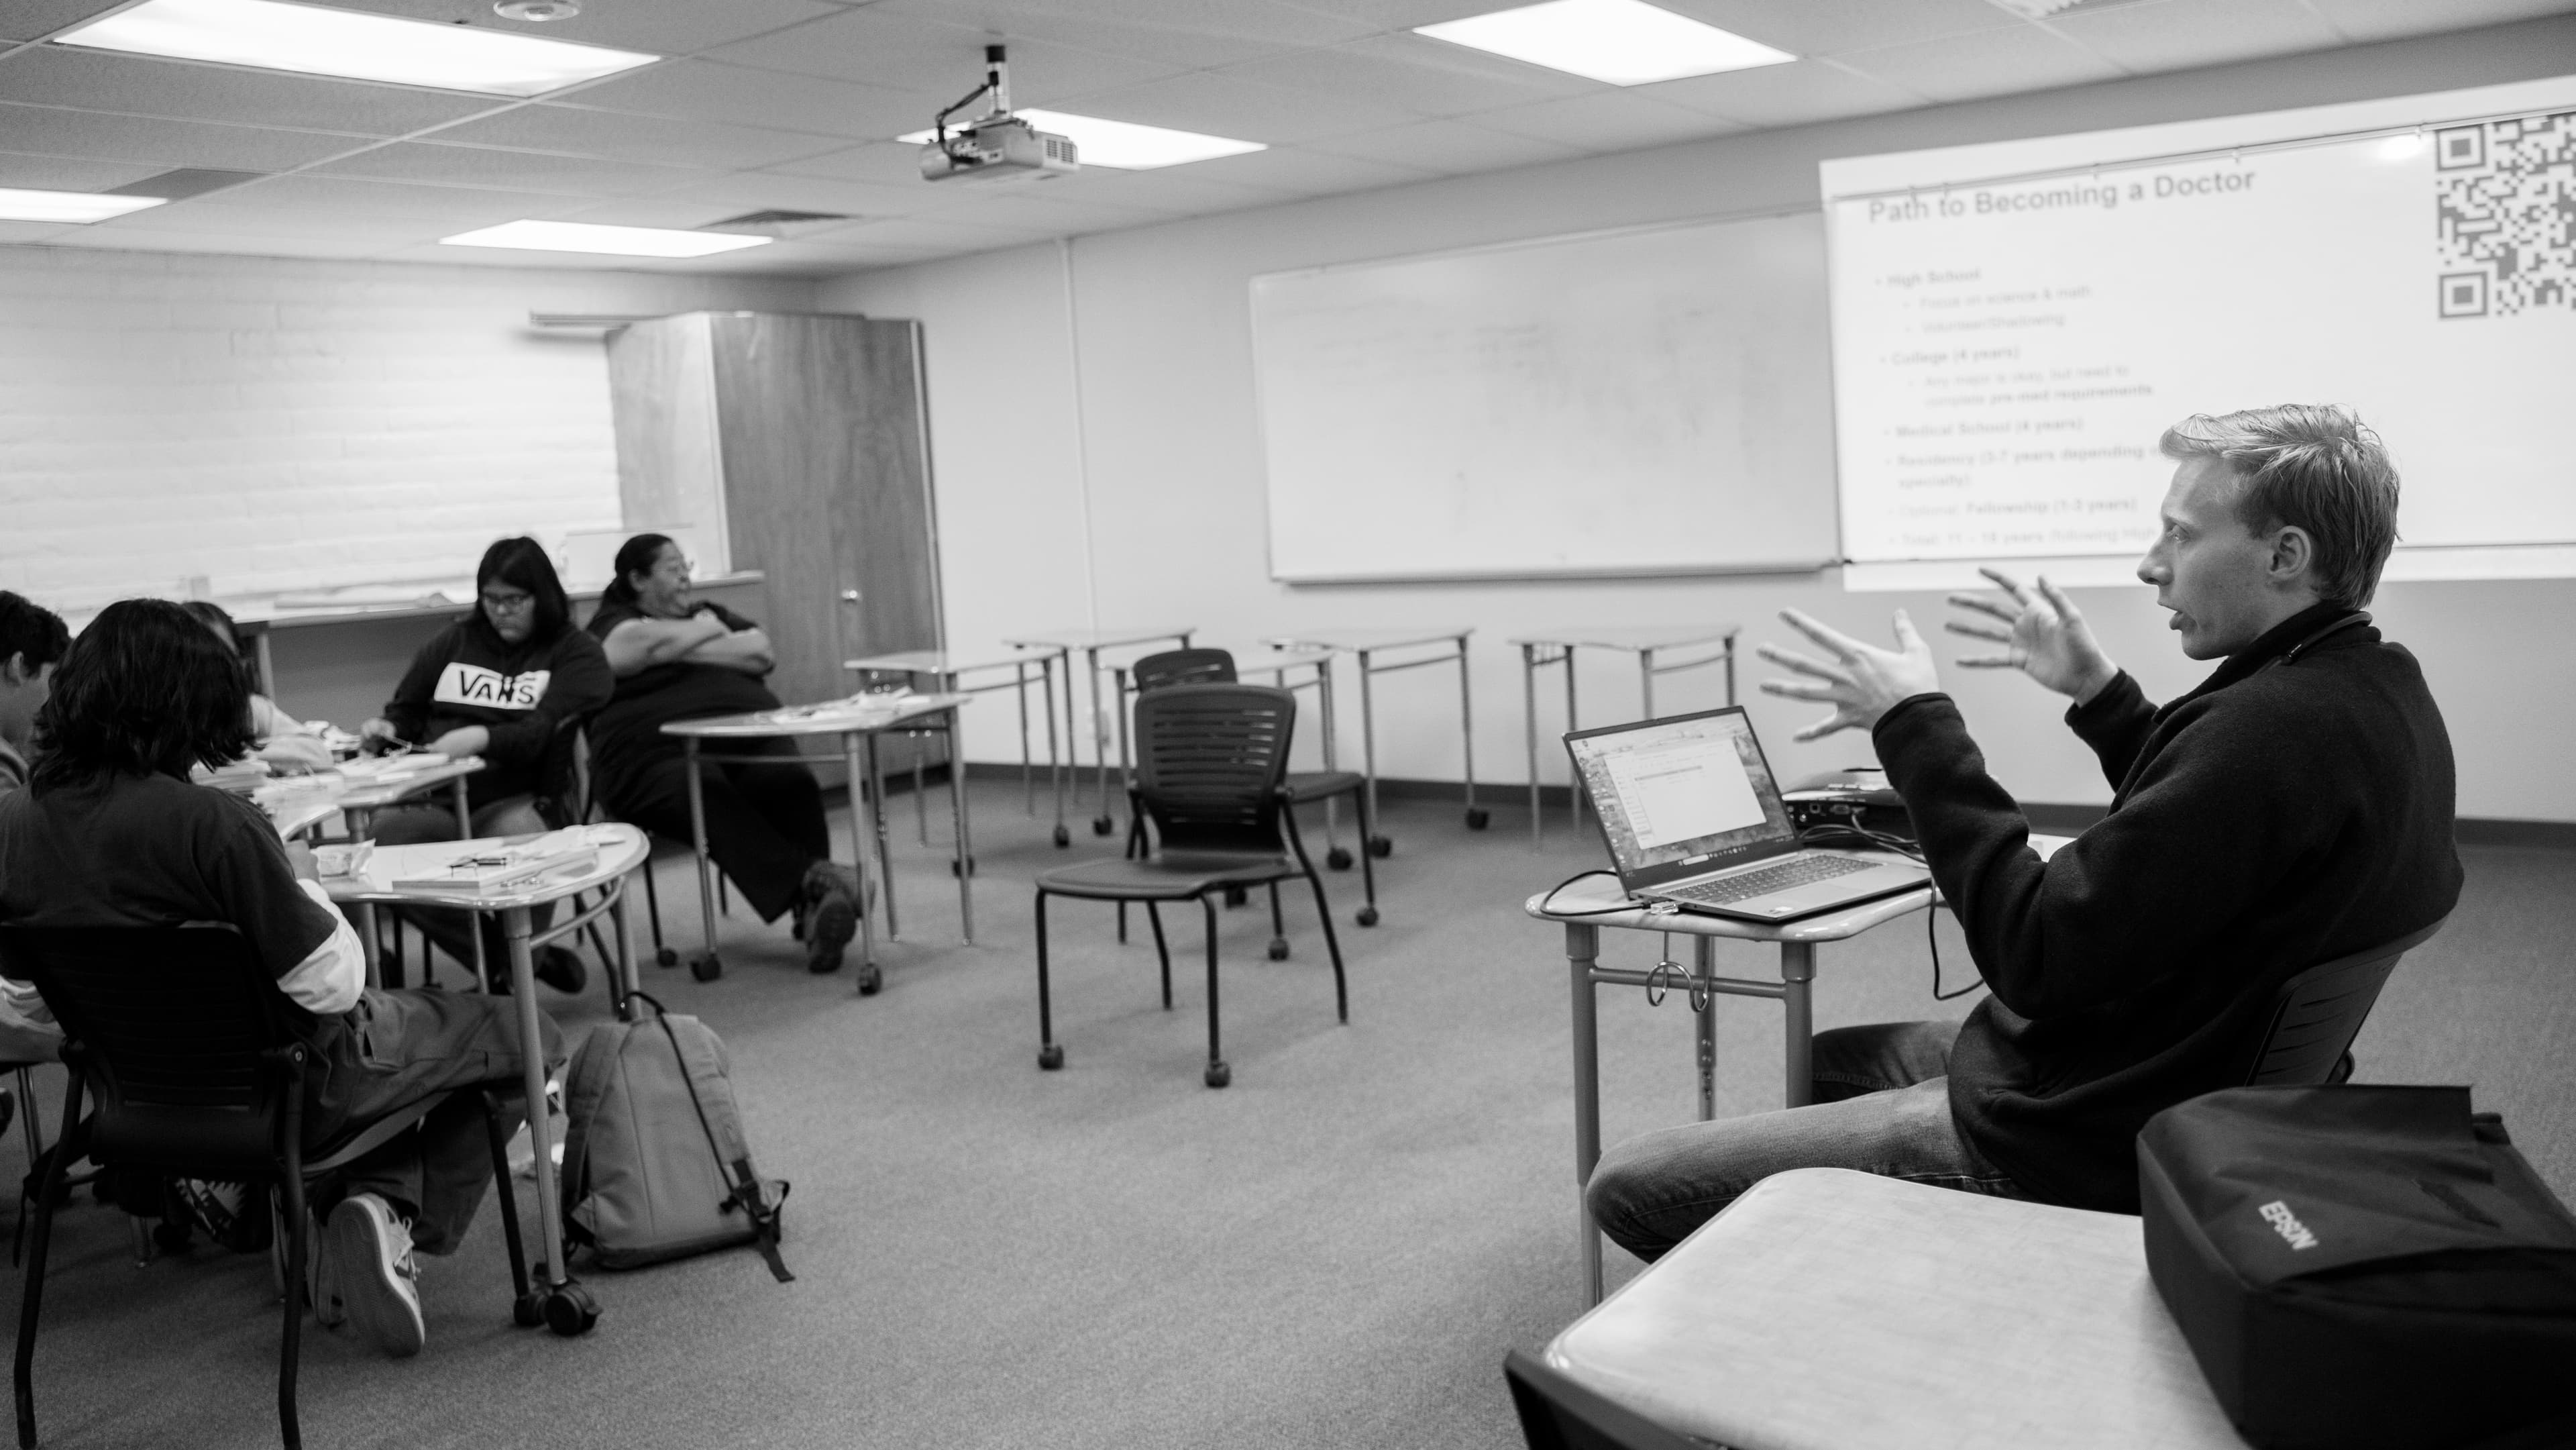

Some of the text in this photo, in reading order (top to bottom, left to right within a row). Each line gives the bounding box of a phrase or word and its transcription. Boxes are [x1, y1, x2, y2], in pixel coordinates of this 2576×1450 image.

[1870, 171, 2255, 223] Path to Becoming a Doctor
[1886, 266, 1980, 289] High School
[1891, 350, 1947, 366] College
[460, 670, 534, 705] VANS
[2259, 1200, 2318, 1249] EPSON
